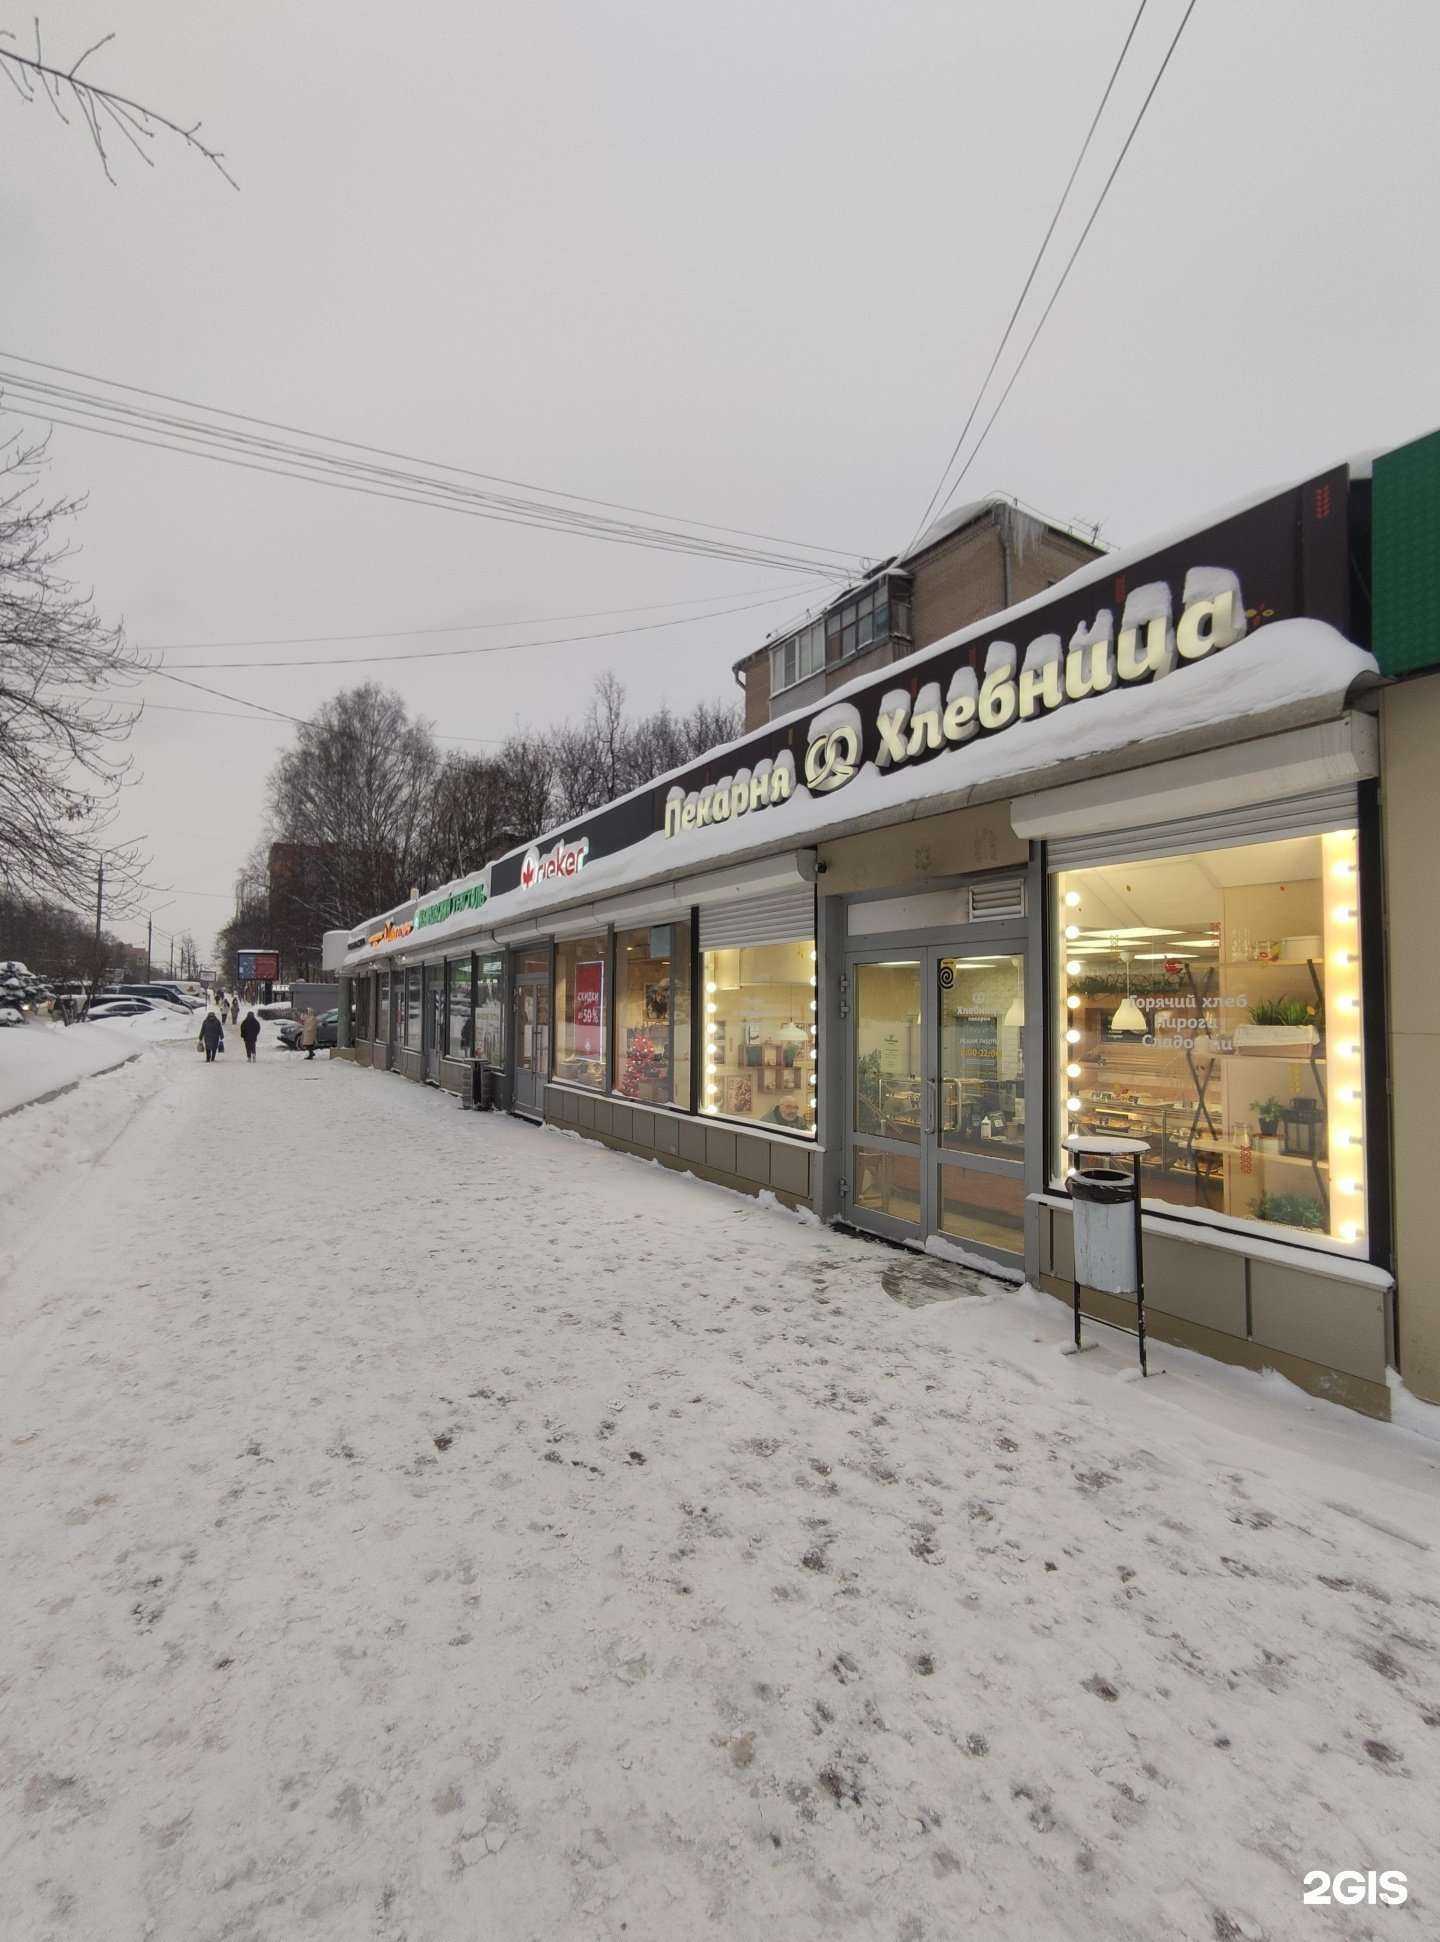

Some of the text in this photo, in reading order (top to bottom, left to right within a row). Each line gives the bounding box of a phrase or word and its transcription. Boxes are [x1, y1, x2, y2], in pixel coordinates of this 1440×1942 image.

[664, 586, 1243, 839] Пекарня Хлебница
[1129, 994, 1248, 1012] Горячий хлеб
